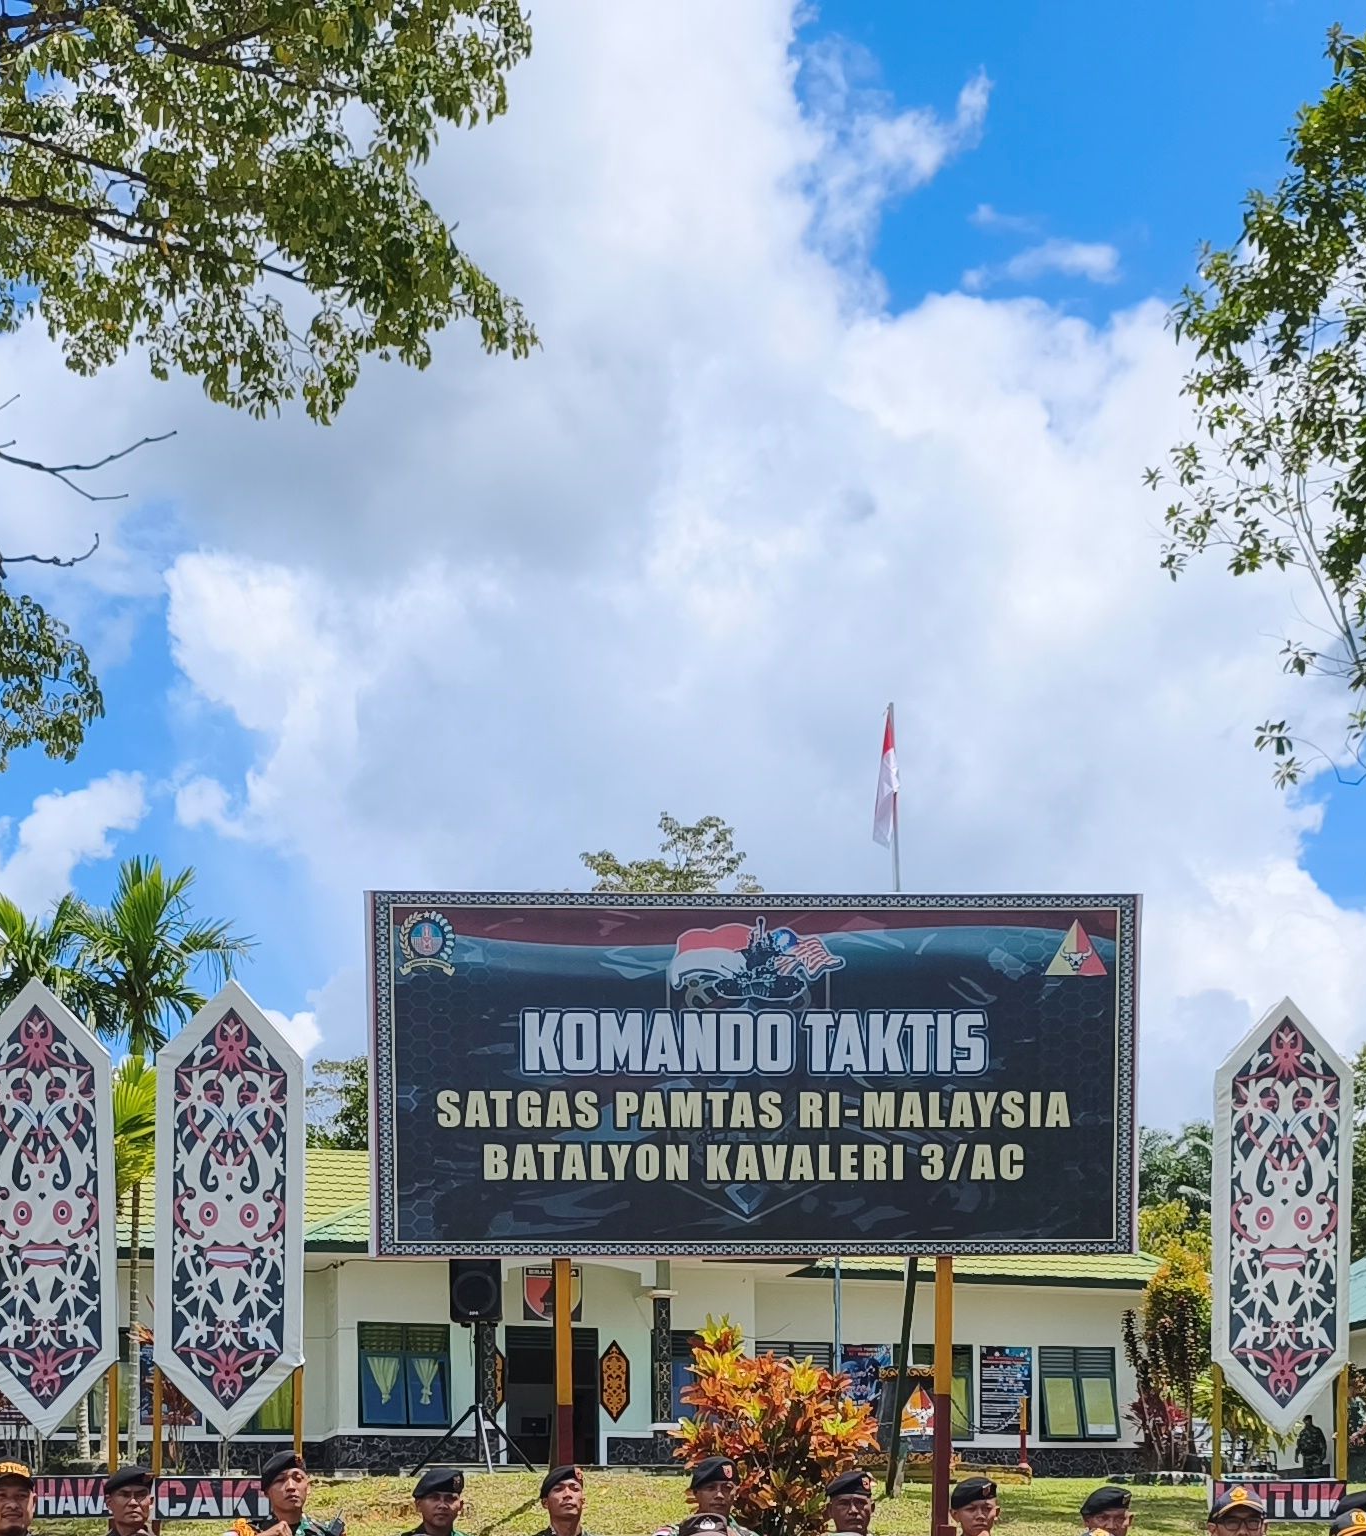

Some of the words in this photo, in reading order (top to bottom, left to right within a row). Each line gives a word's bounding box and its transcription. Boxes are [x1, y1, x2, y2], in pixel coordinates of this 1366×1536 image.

[522, 1010, 794, 1073] KOMANDO
[803, 1010, 987, 1074] TAKTIS
[437, 1090, 599, 1128] SATGAS
[616, 1090, 782, 1128] PAMTAS
[800, 1091, 1071, 1128] RI-MALAYSIA
[484, 1143, 689, 1181] BATALYON
[707, 1143, 904, 1181] KAVALERI
[921, 1143, 1025, 1181] 3/AC
[157, 1479, 269, 1516] CAKT
